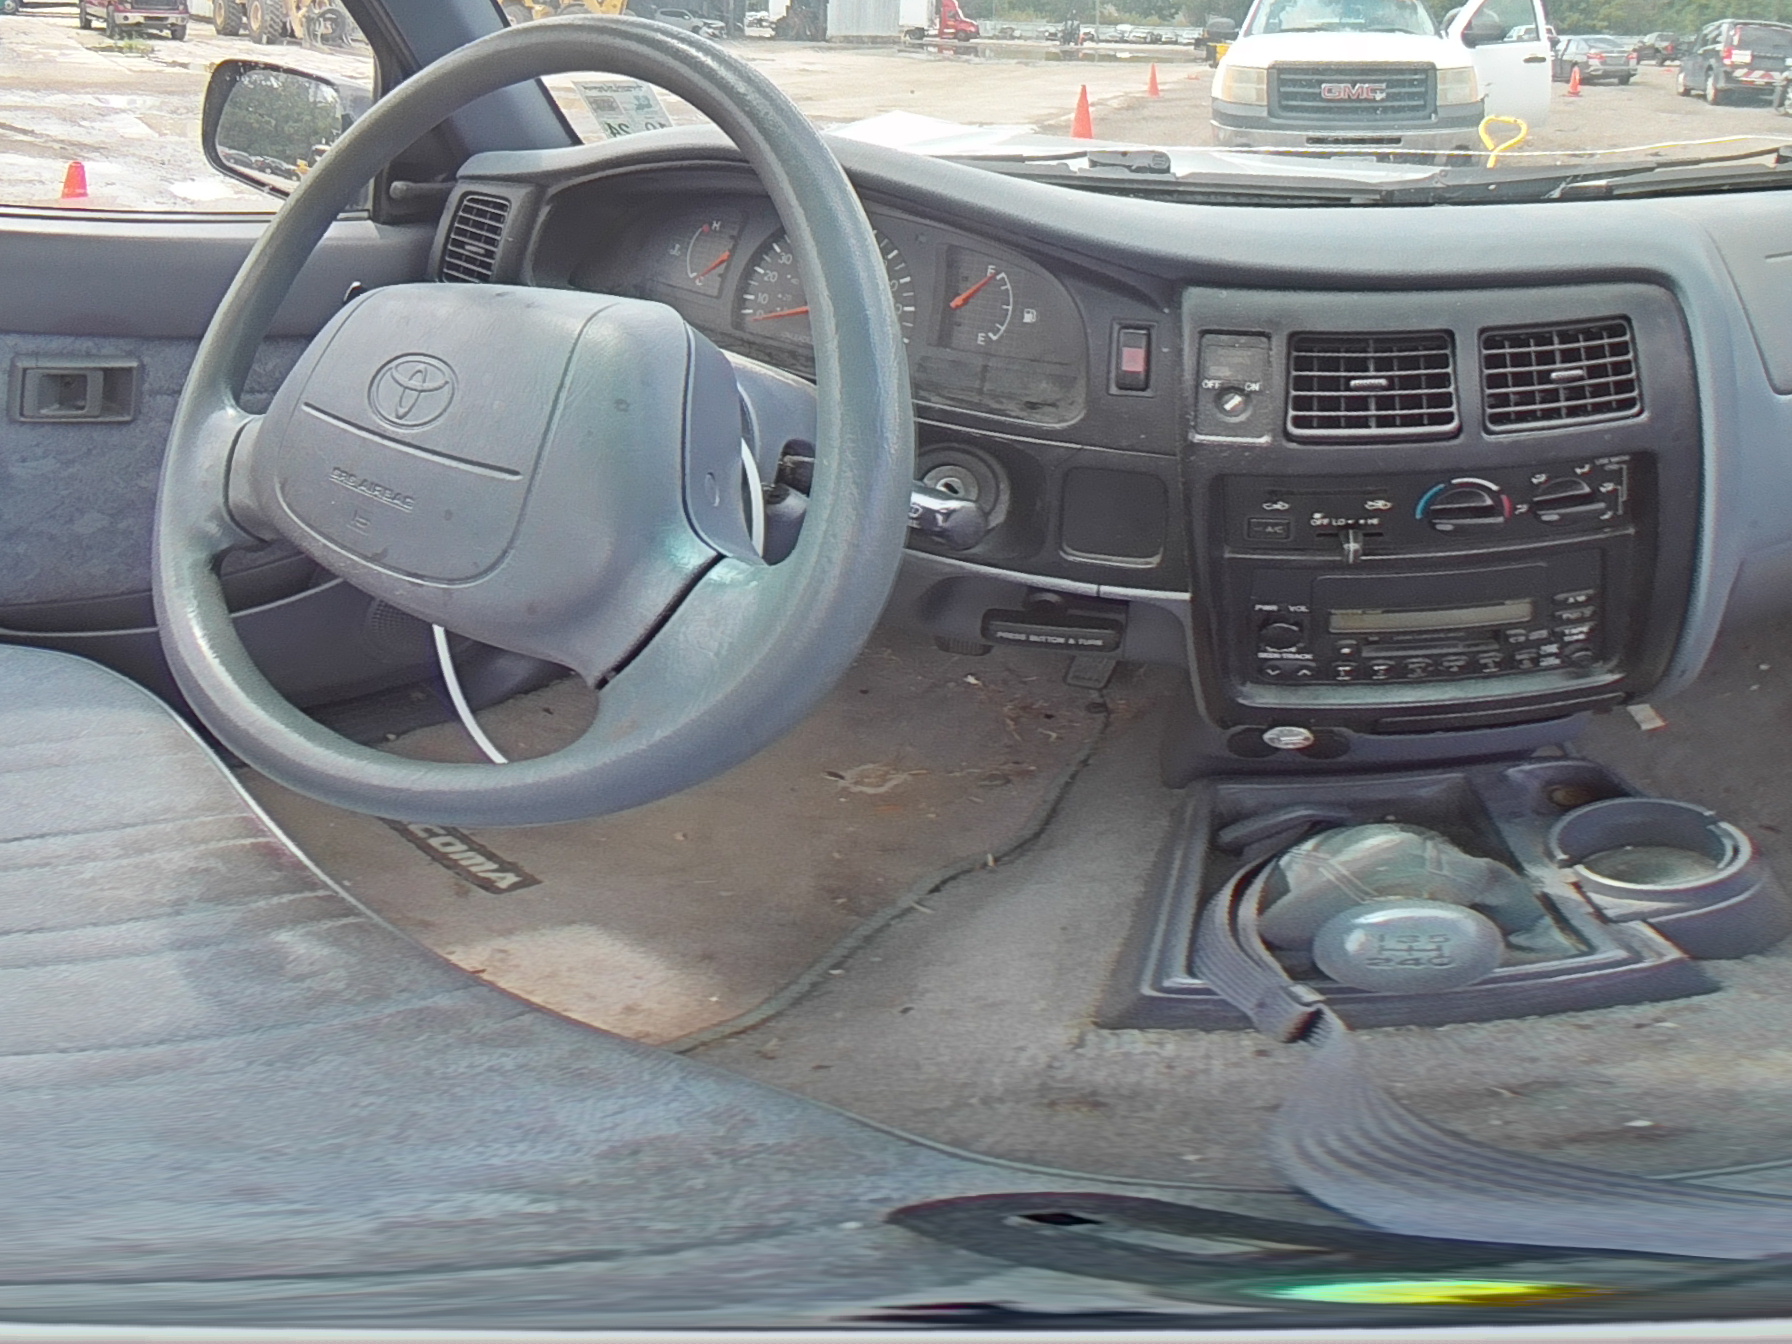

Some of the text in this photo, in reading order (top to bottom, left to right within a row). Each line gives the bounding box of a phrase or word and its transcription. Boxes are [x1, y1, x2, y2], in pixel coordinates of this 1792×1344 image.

[1321, 83, 1386, 100] GMC
[777, 252, 793, 265] 30
[763, 270, 778, 283] 20
[757, 293, 769, 304] 10
[976, 332, 987, 346] E
[1202, 379, 1221, 389] OFF
[1245, 382, 1261, 392] ON
[1310, 518, 1329, 526] OFF
[1332, 518, 1346, 526] LO
[1288, 605, 1309, 613] VOL
[408, 823, 523, 889] COMA
